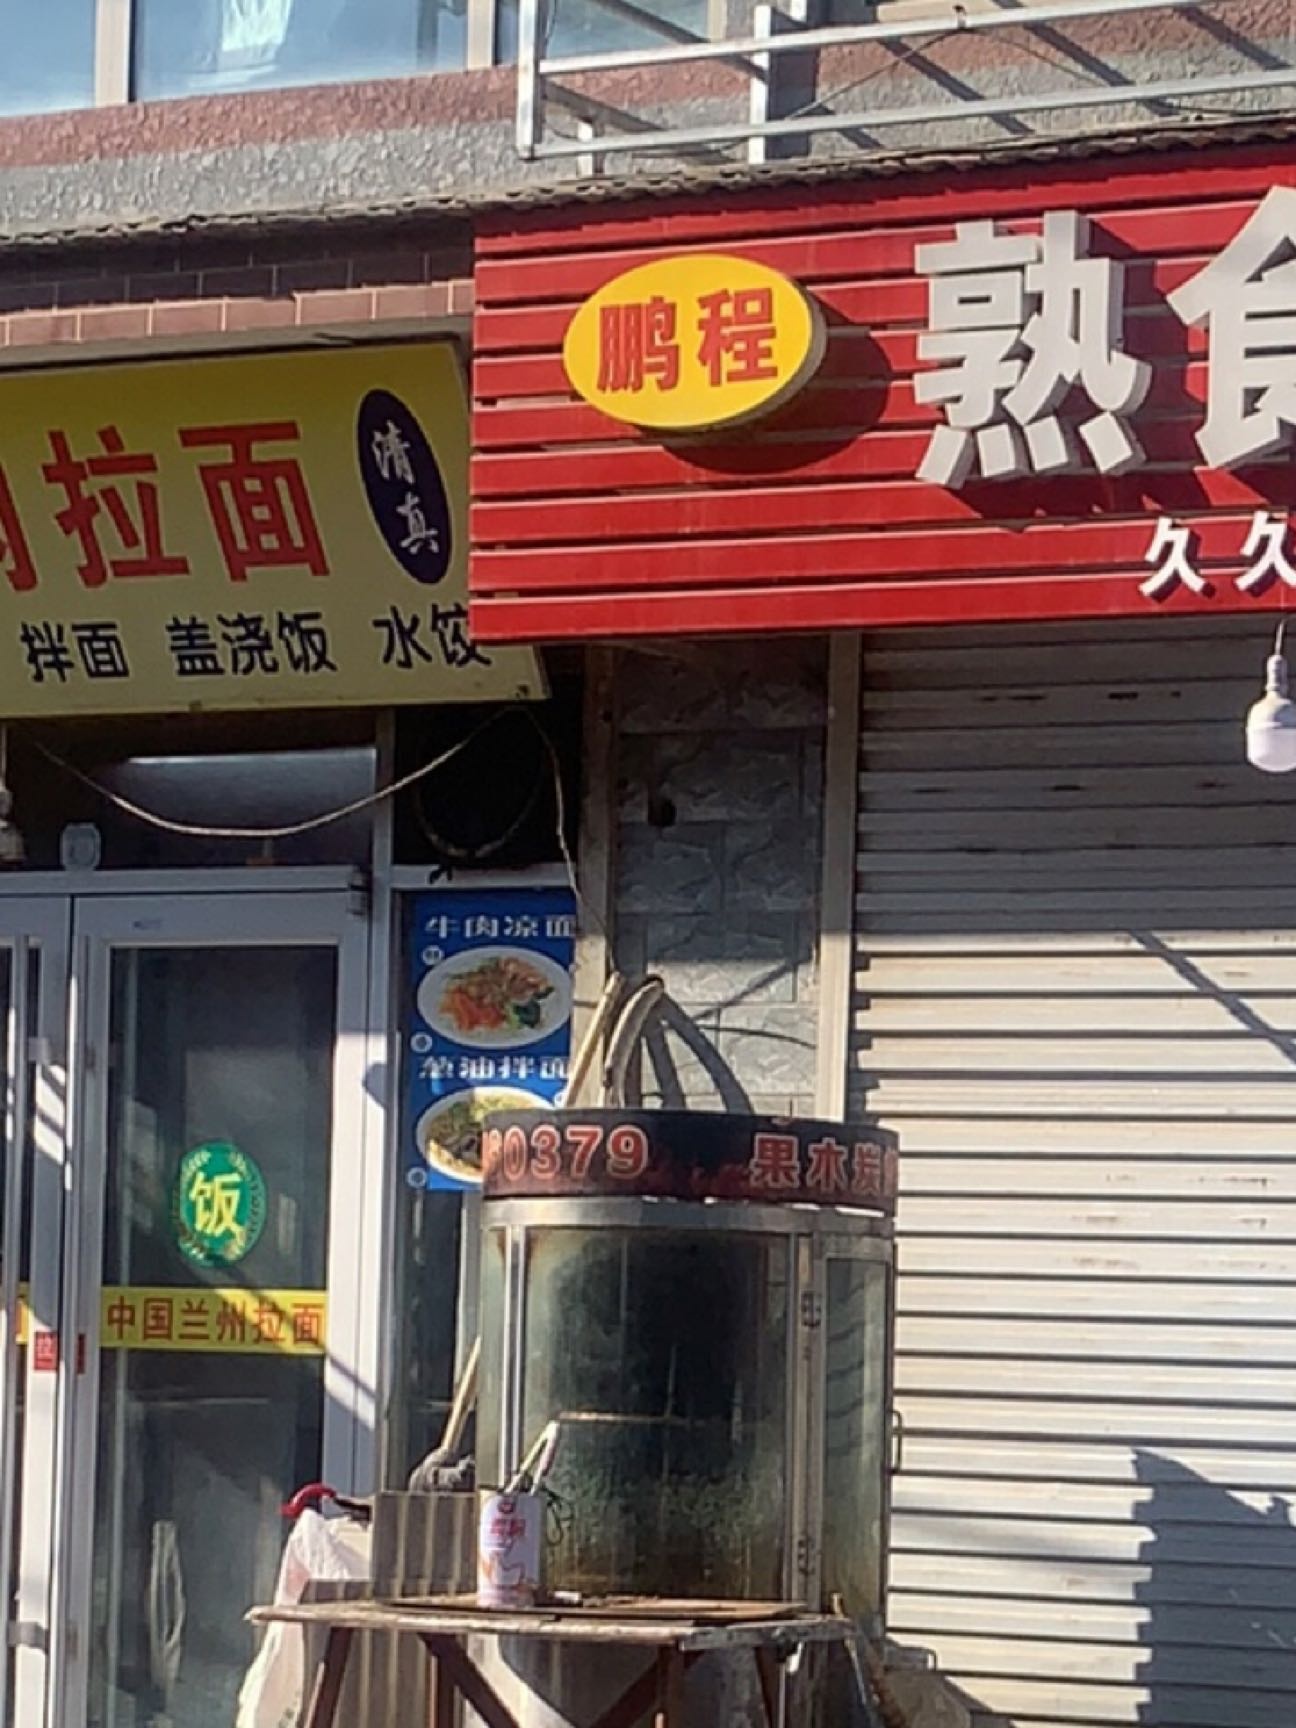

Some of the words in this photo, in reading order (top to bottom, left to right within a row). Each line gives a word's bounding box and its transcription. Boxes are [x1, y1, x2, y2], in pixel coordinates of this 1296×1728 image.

[596, 288, 781, 393] 鹏程
[371, 419, 440, 555] 清真
[20, 619, 131, 683] 拌面
[165, 611, 338, 677] 盖浇饭
[372, 603, 493, 669] 水饺
[748, 1131, 899, 1197] 果木炭
[188, 1171, 247, 1238] 饭
[107, 1296, 325, 1345] 中国兰州拉面
